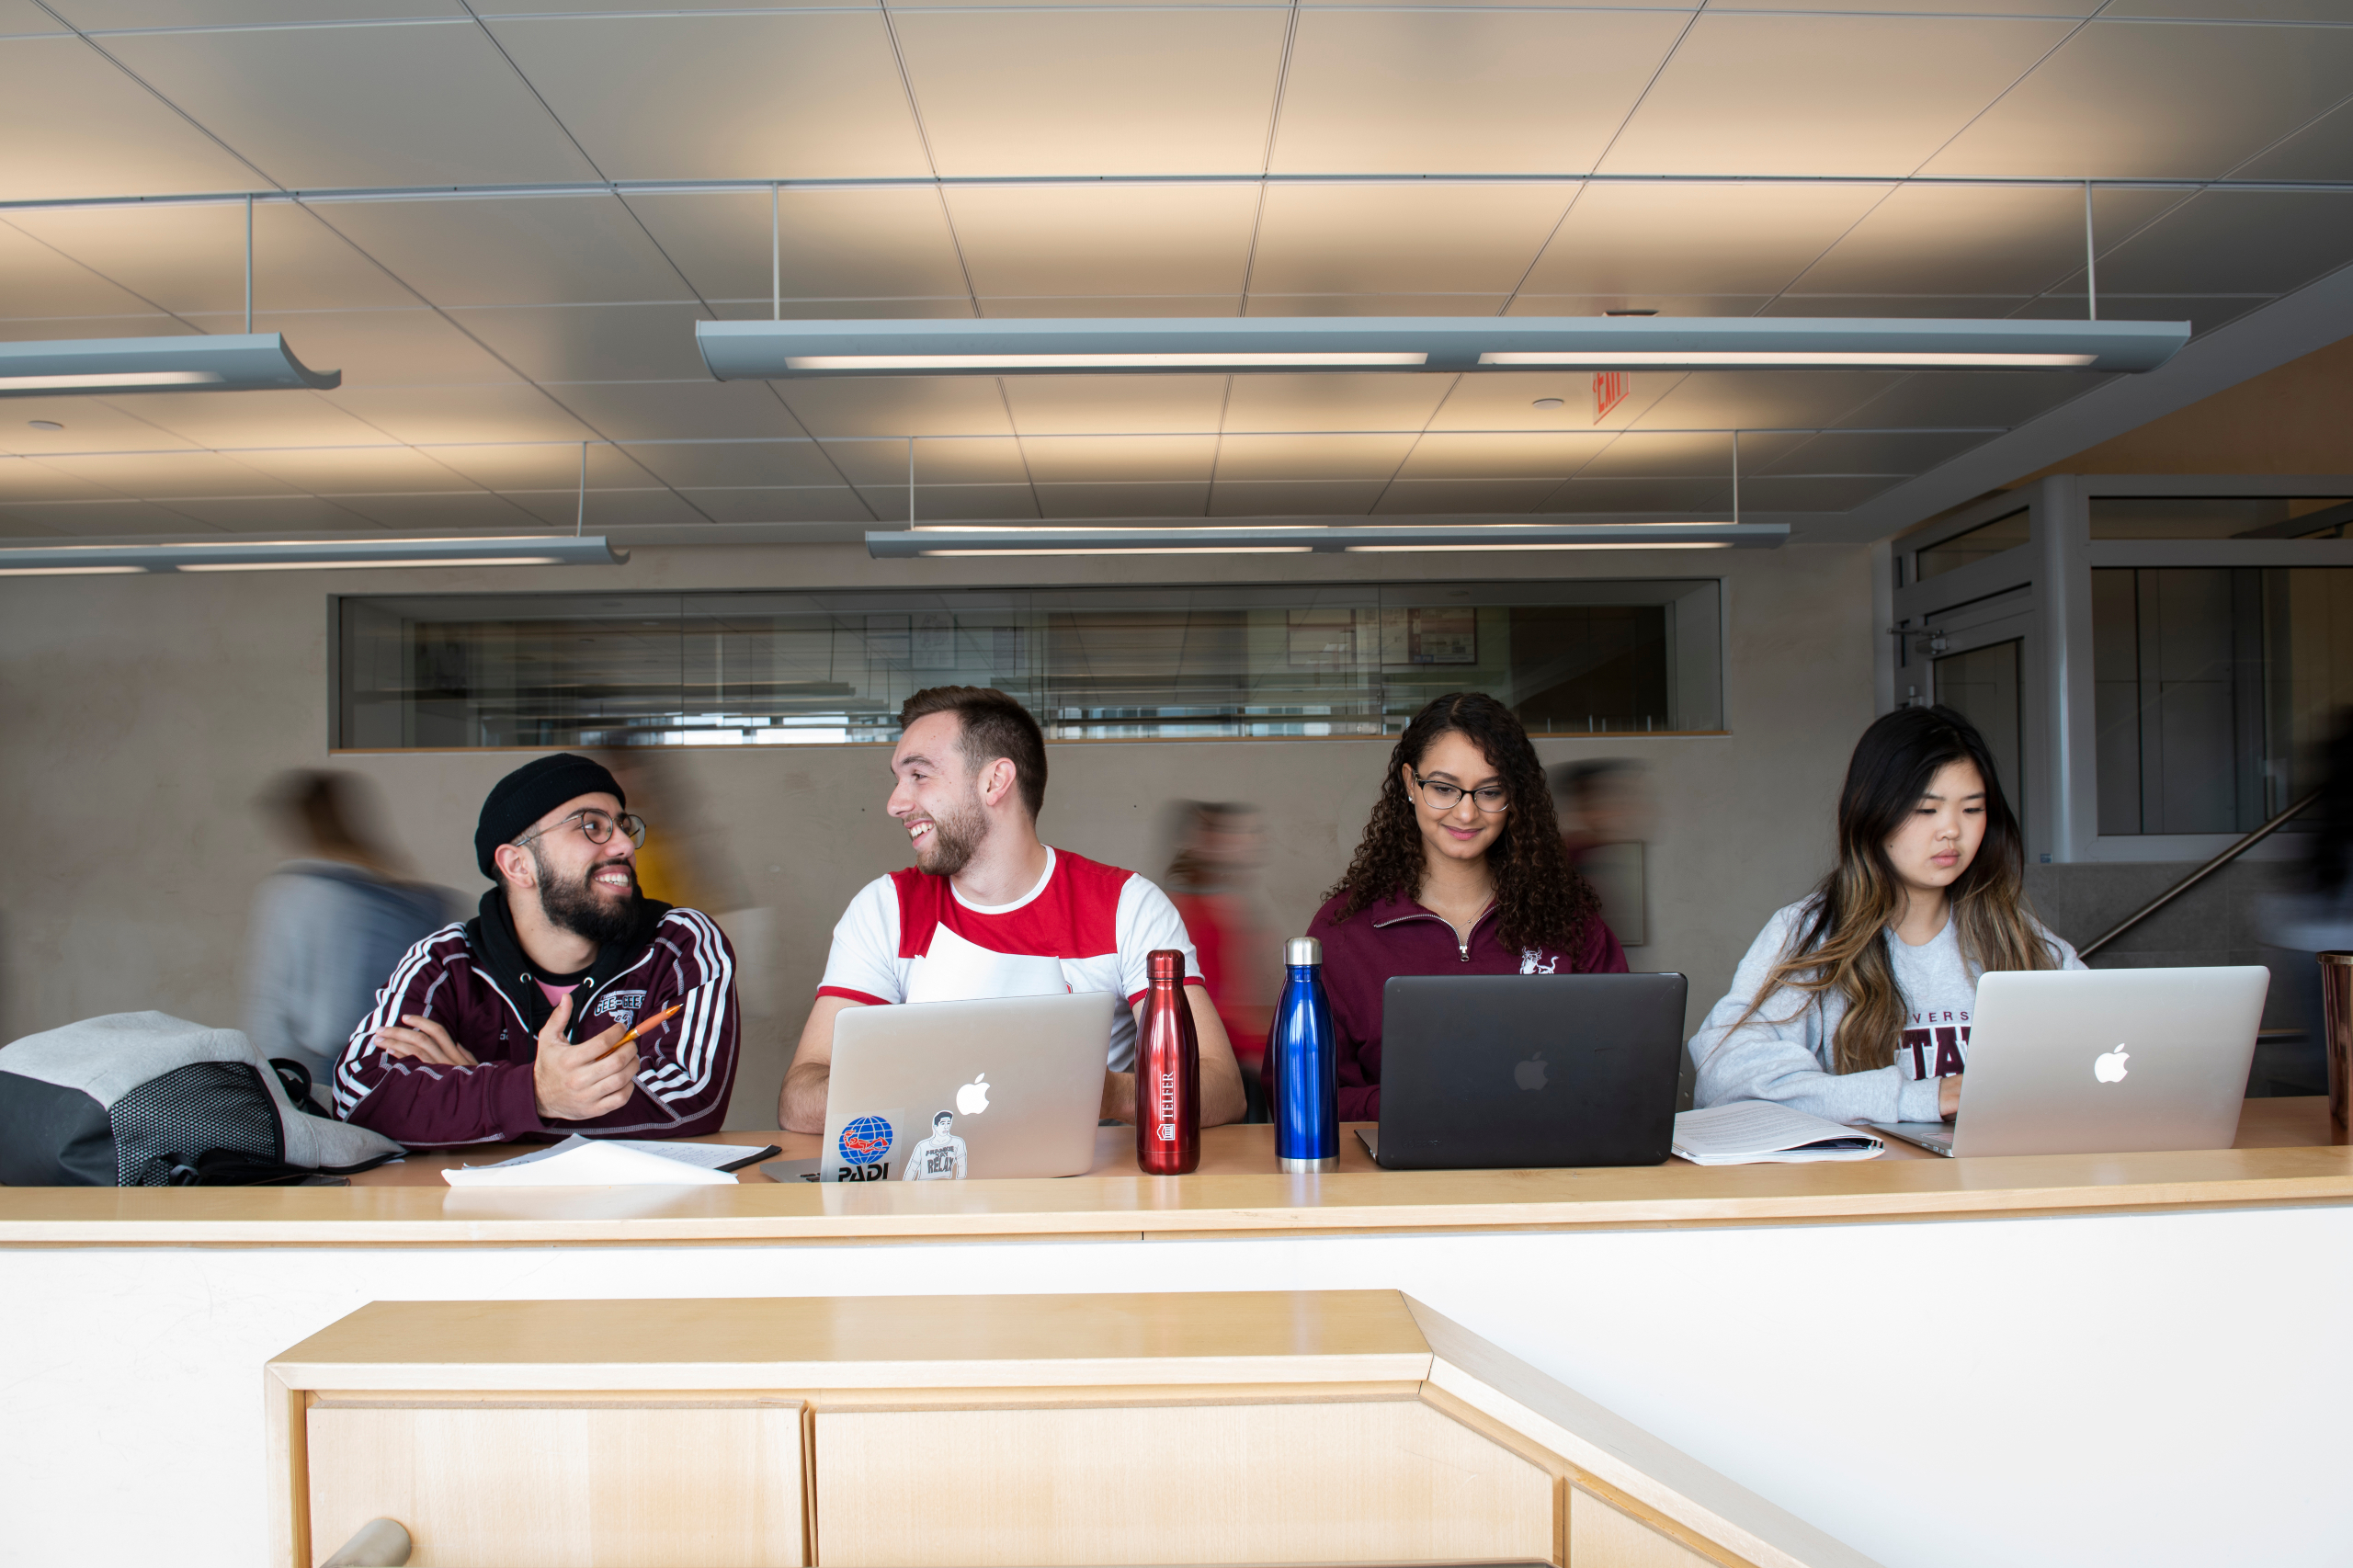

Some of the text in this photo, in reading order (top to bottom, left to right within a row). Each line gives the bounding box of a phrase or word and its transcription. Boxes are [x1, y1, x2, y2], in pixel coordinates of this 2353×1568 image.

[1913, 1011, 1969, 1023] VERS
[1161, 1071, 1174, 1120] TELFER
[838, 1162, 889, 1182] PADI
[927, 1156, 953, 1174] RELAX
